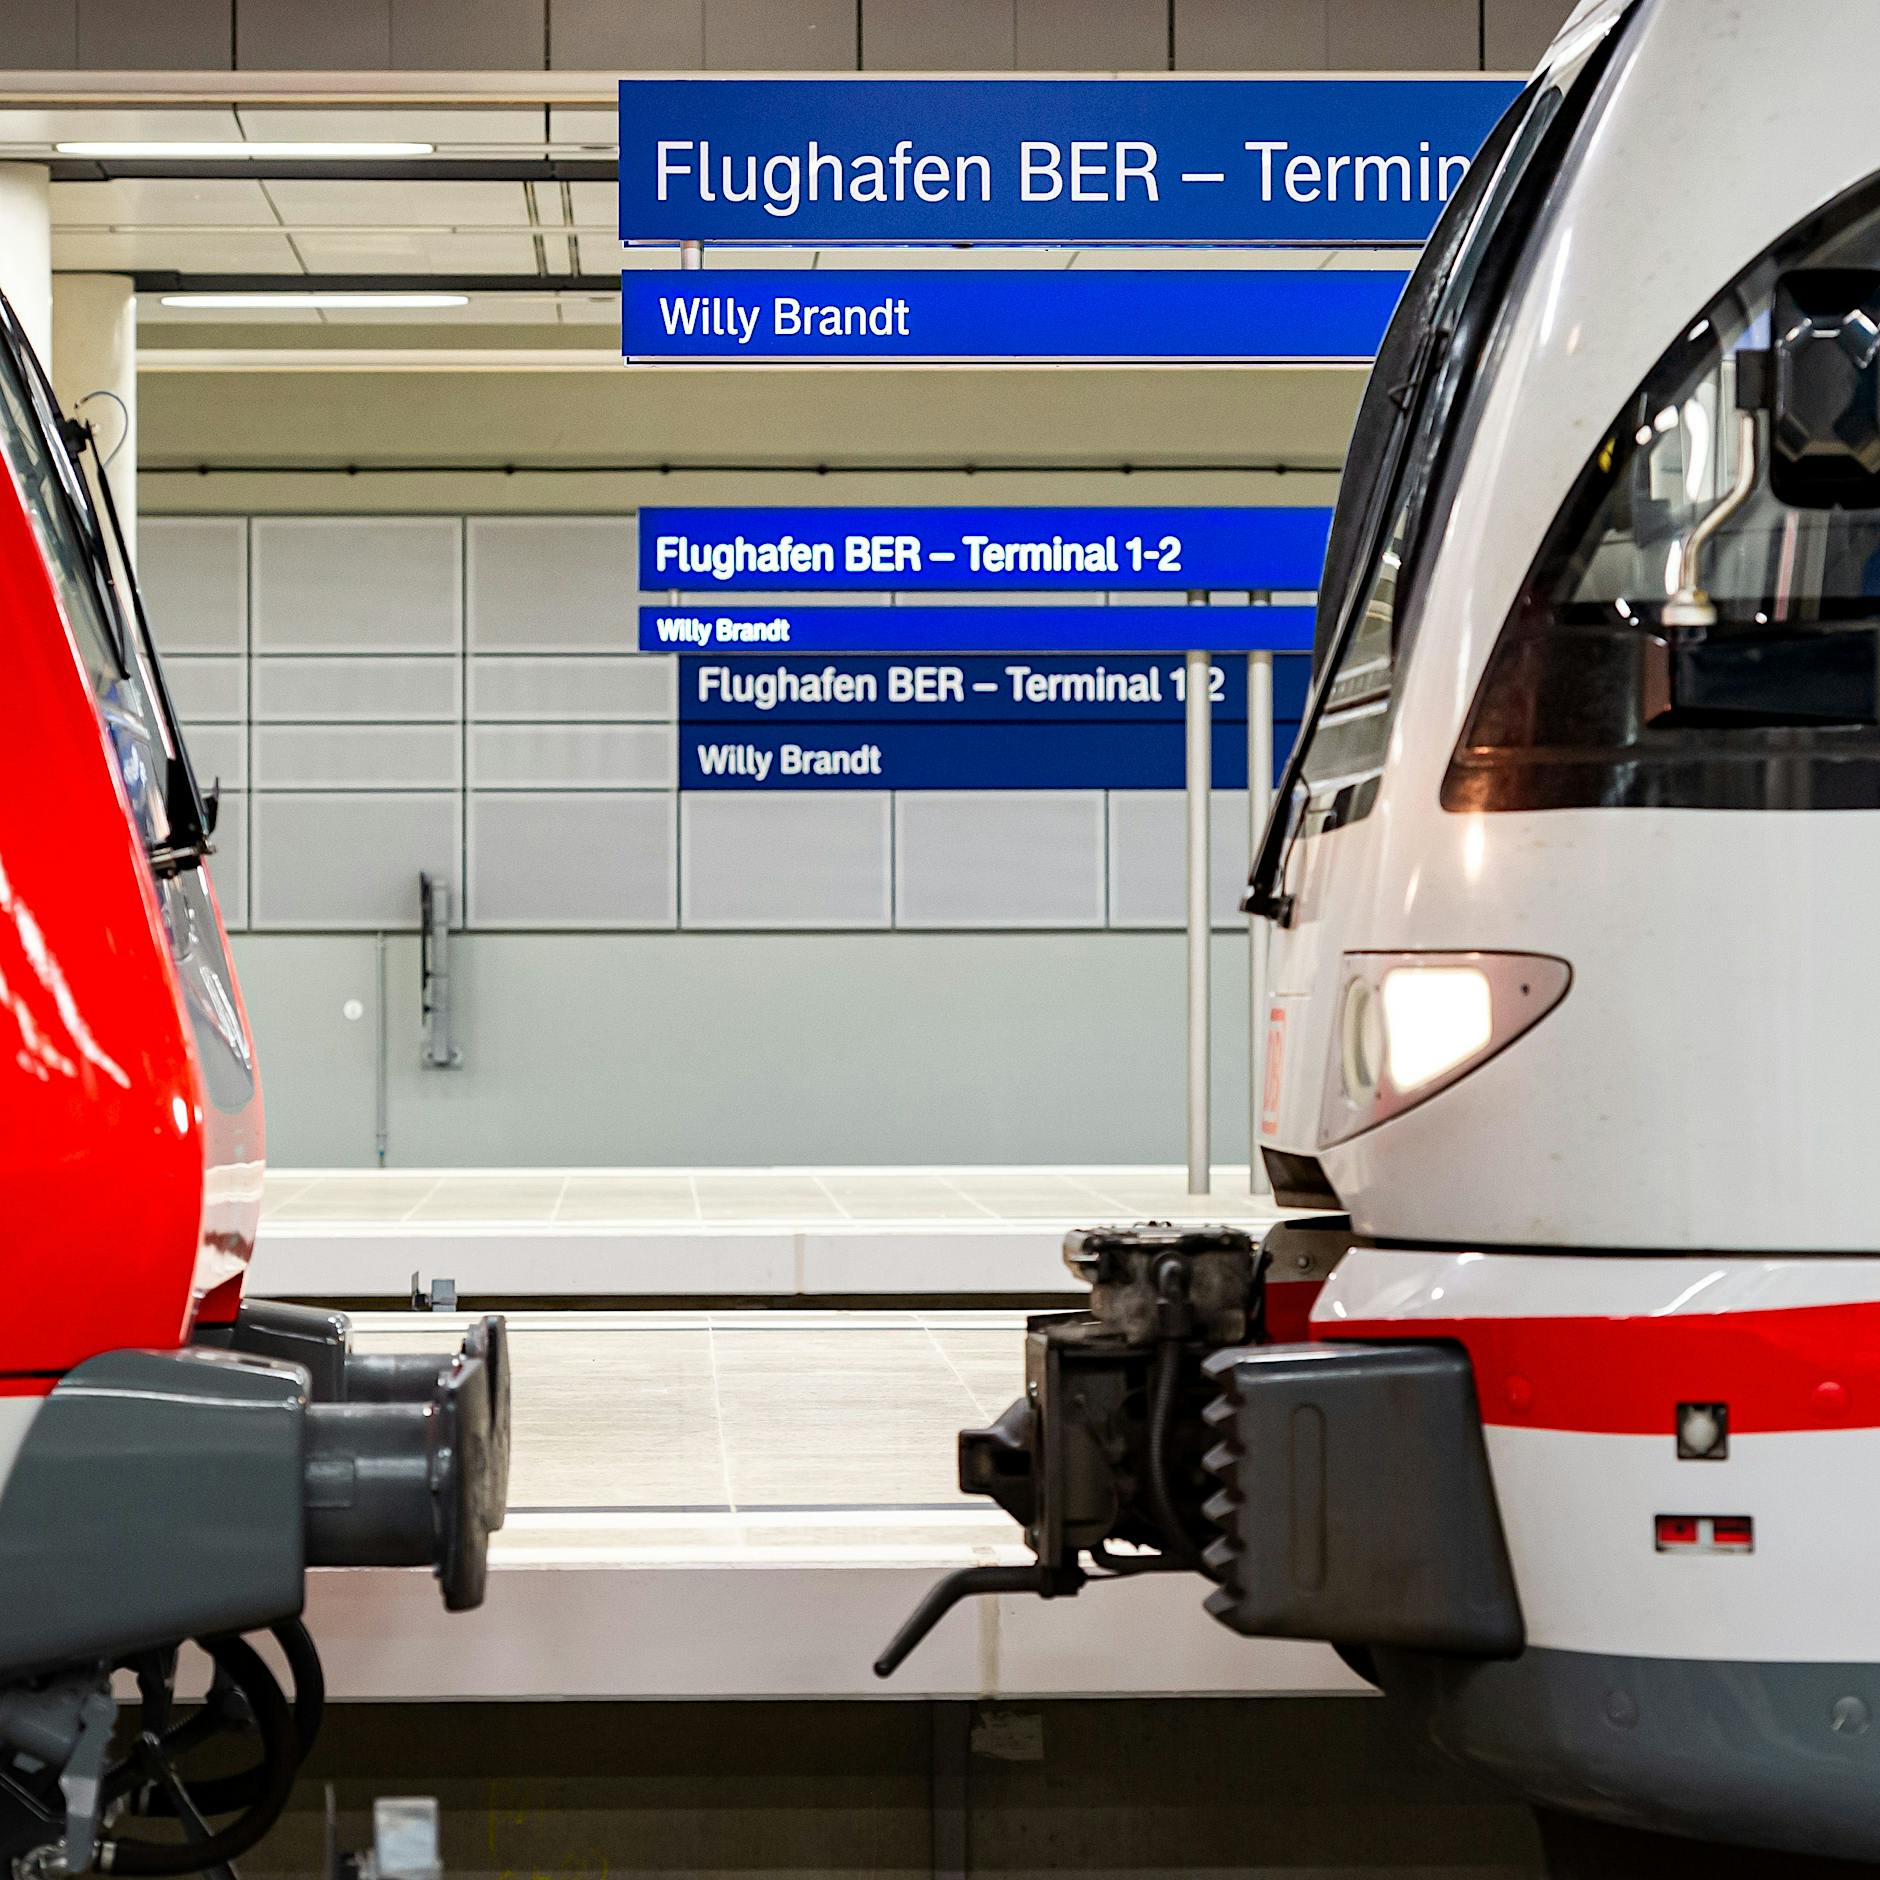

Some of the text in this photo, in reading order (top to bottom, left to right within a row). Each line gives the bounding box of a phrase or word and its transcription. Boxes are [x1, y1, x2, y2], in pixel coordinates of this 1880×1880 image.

[657, 140, 991, 217] Flughafen
[1020, 141, 1159, 202] BER
[1244, 141, 1472, 202] Termin
[659, 297, 910, 344] Willy Brandt
[656, 535, 834, 580] Flughafen
[845, 535, 922, 572] BER
[961, 535, 1119, 573] Terminal
[1125, 535, 1182, 572] 1-2
[656, 617, 791, 645] Willy Brandt
[698, 666, 877, 710] Flughafen
[888, 666, 965, 702] BER
[1004, 666, 1162, 703] Terminal
[1169, 666, 1226, 702] 12
[697, 744, 882, 781] Willy Brandt
